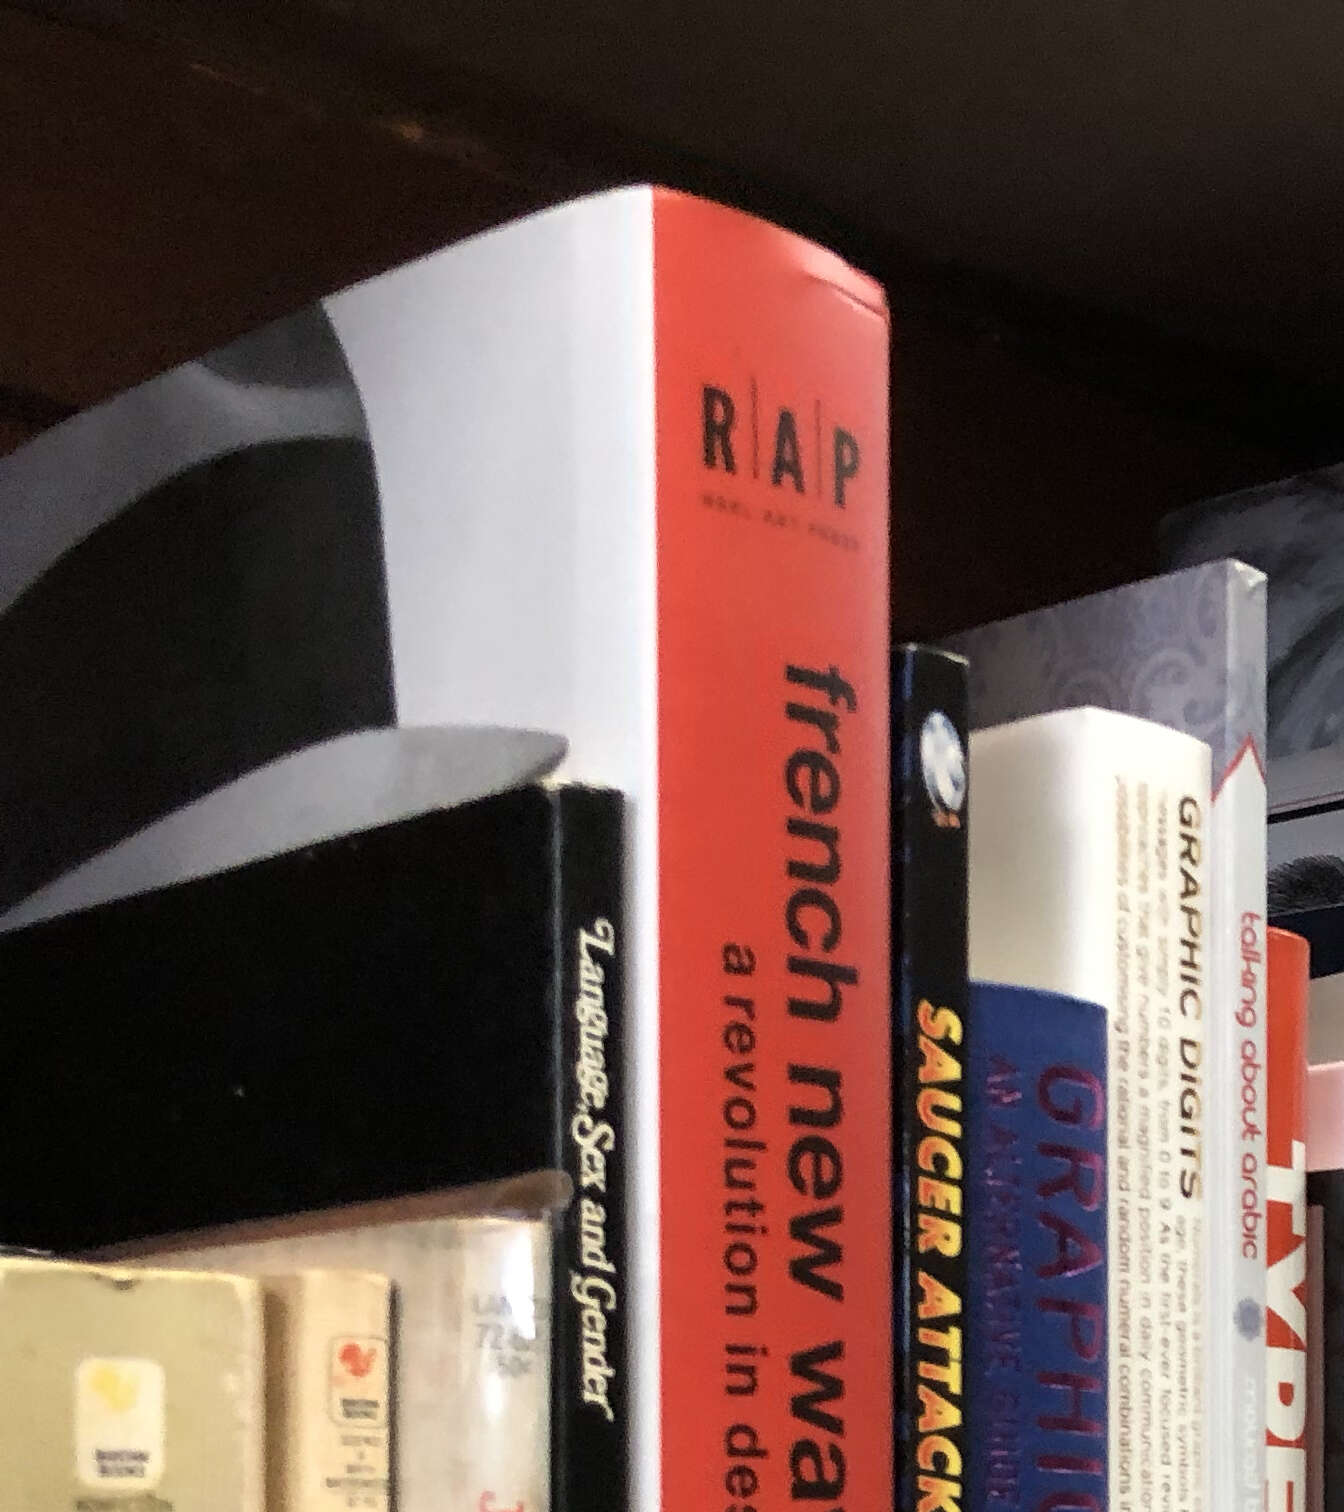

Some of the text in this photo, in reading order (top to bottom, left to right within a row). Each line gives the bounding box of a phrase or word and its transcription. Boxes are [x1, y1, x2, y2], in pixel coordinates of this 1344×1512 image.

[783, 661, 862, 1023] french
[1177, 795, 1203, 1019] GRAPHIC
[722, 995, 772, 1317] revolution
[790, 1066, 858, 1303] new
[914, 999, 962, 1257] SAUCER
[1178, 1036, 1203, 1202] DIGITS
[568, 1275, 618, 1421] Gender
[722, 1345, 768, 1397] in
